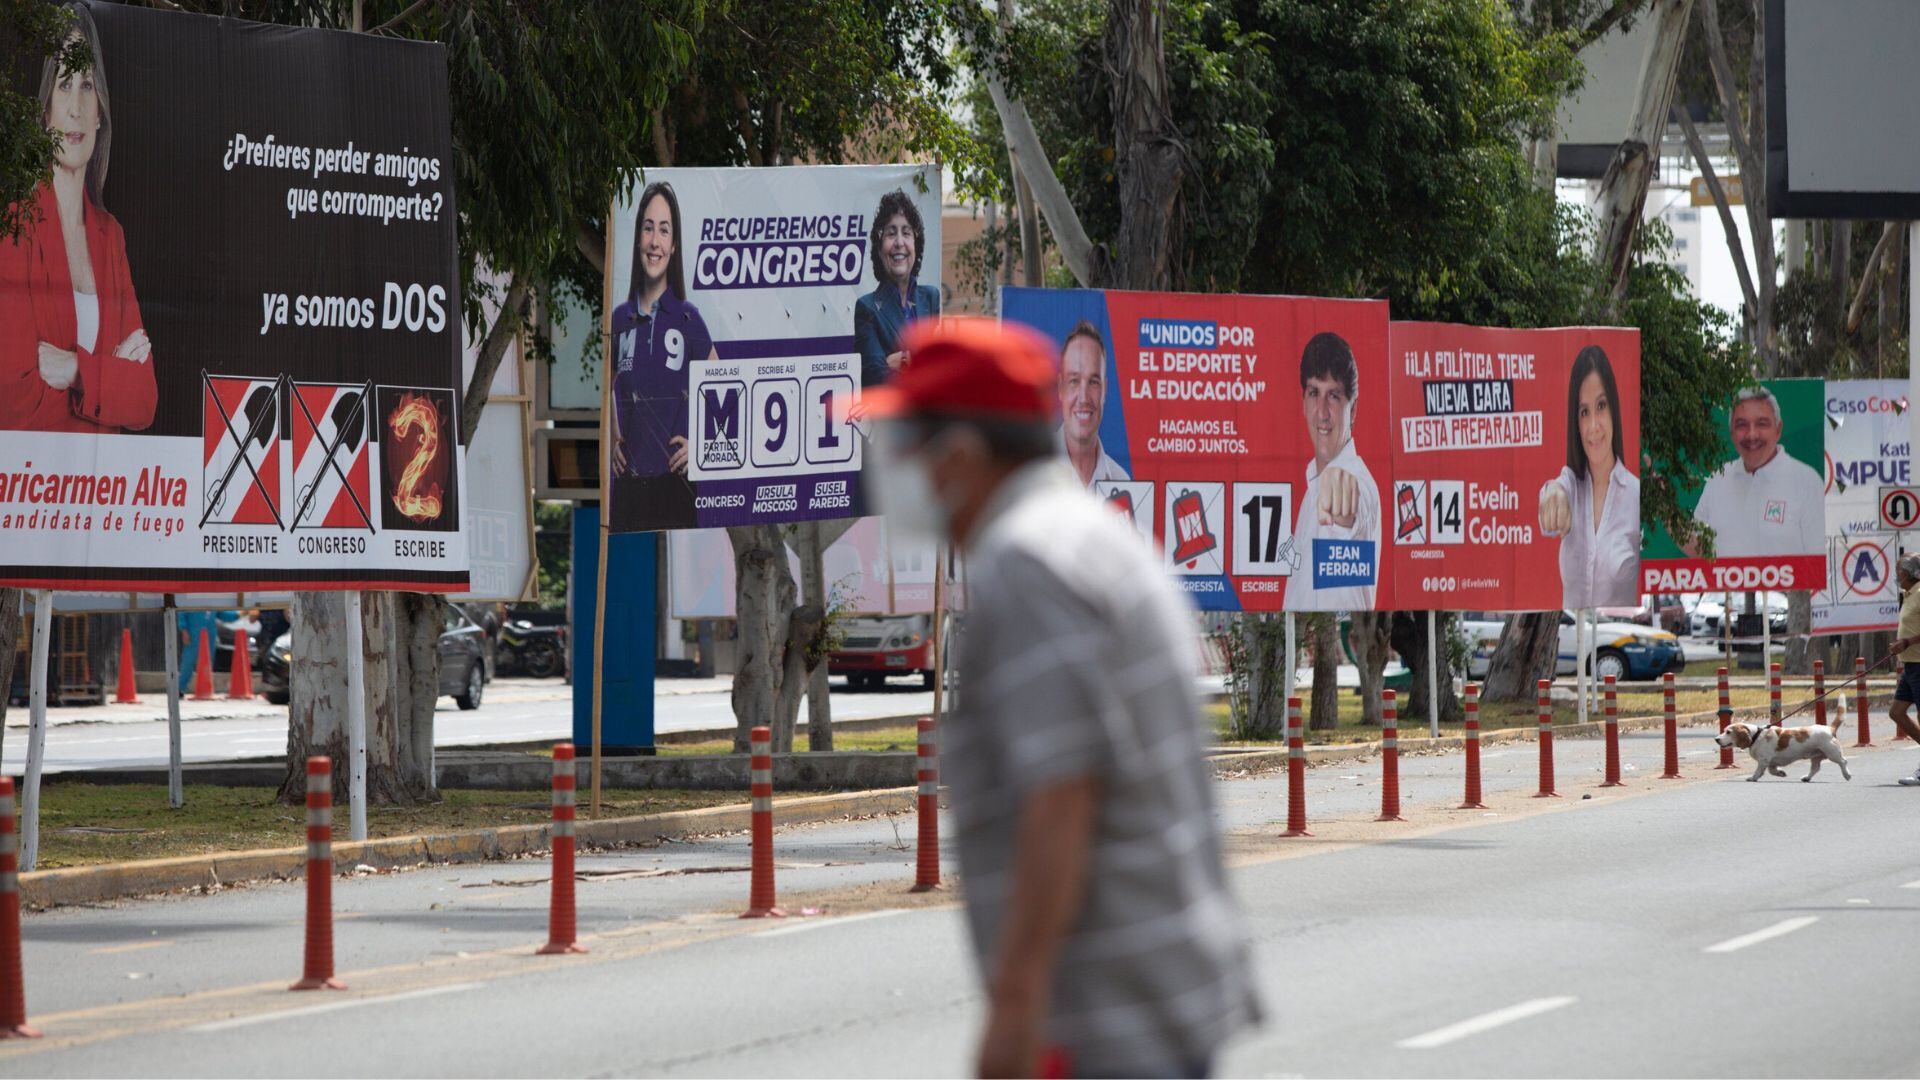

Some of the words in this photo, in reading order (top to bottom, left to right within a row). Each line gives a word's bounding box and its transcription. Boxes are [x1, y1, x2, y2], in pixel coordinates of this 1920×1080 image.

[223, 133, 310, 171] ¿Prefieres
[313, 141, 371, 179] perder
[374, 147, 440, 187] amigos
[287, 187, 318, 219] que
[322, 192, 443, 226] corromperte?
[701, 215, 842, 241] RECUPEREMOS
[846, 215, 868, 238] EL
[696, 244, 862, 286] CONGRESO
[260, 293, 289, 335] ya
[294, 295, 375, 329] somos
[382, 282, 446, 333] DOS
[1219, 326, 1255, 347] POR
[664, 328, 685, 371] 9
[705, 367, 728, 377] MARCA
[729, 366, 740, 376] ASÍ
[757, 365, 784, 375] ESCRIBE
[785, 363, 796, 374] ASÍ
[811, 362, 837, 372] ESCRIBE
[837, 360, 848, 371] ASÍ
[1139, 351, 1159, 372] EL
[1163, 352, 1242, 373] DEPORTE
[1245, 354, 1257, 374] Y
[1435, 348, 1494, 379] POLÍTICA
[1498, 353, 1536, 380] TIENE
[1130, 379, 1152, 399] LA
[1426, 383, 1469, 413] NUEVA
[1473, 382, 1511, 411] CARA
[704, 388, 739, 440] M
[764, 391, 788, 453] 9
[818, 389, 839, 449] 1
[1159, 419, 1220, 435] HAGAMOS
[1223, 420, 1237, 435] EL
[1405, 420, 1412, 448] Y
[1415, 415, 1448, 448] ESTÁ
[1451, 414, 1540, 446] PREPARADA!!
[704, 440, 738, 452] PARTIDO
[704, 452, 738, 463] MORADO
[1148, 438, 1196, 453] CAMBIO
[393, 399, 442, 518] 2
[131, 465, 188, 507] Alva
[757, 485, 794, 499] URSULA
[816, 482, 845, 495] SUSEL
[1469, 482, 1519, 510] Evelin
[695, 494, 746, 508] CONGRESO
[752, 499, 798, 514] MOSCOSO
[809, 495, 850, 509] PAREDES
[1433, 491, 1462, 534] 14
[102, 511, 123, 531] de
[133, 511, 185, 537] fuego
[1242, 495, 1283, 563] 17
[1468, 516, 1532, 545] Coloma
[203, 535, 278, 554] PRESIDENTE
[298, 536, 366, 554] CONGRESO
[395, 539, 445, 558] ESCRIBE
[1328, 545, 1360, 560] JEAN
[1318, 561, 1370, 576] FERRARI
[1644, 567, 1708, 592] PARA
[1712, 564, 1795, 589] TODOS
[1852, 551, 1880, 583] A
[1241, 581, 1279, 593] ESCRIBE
